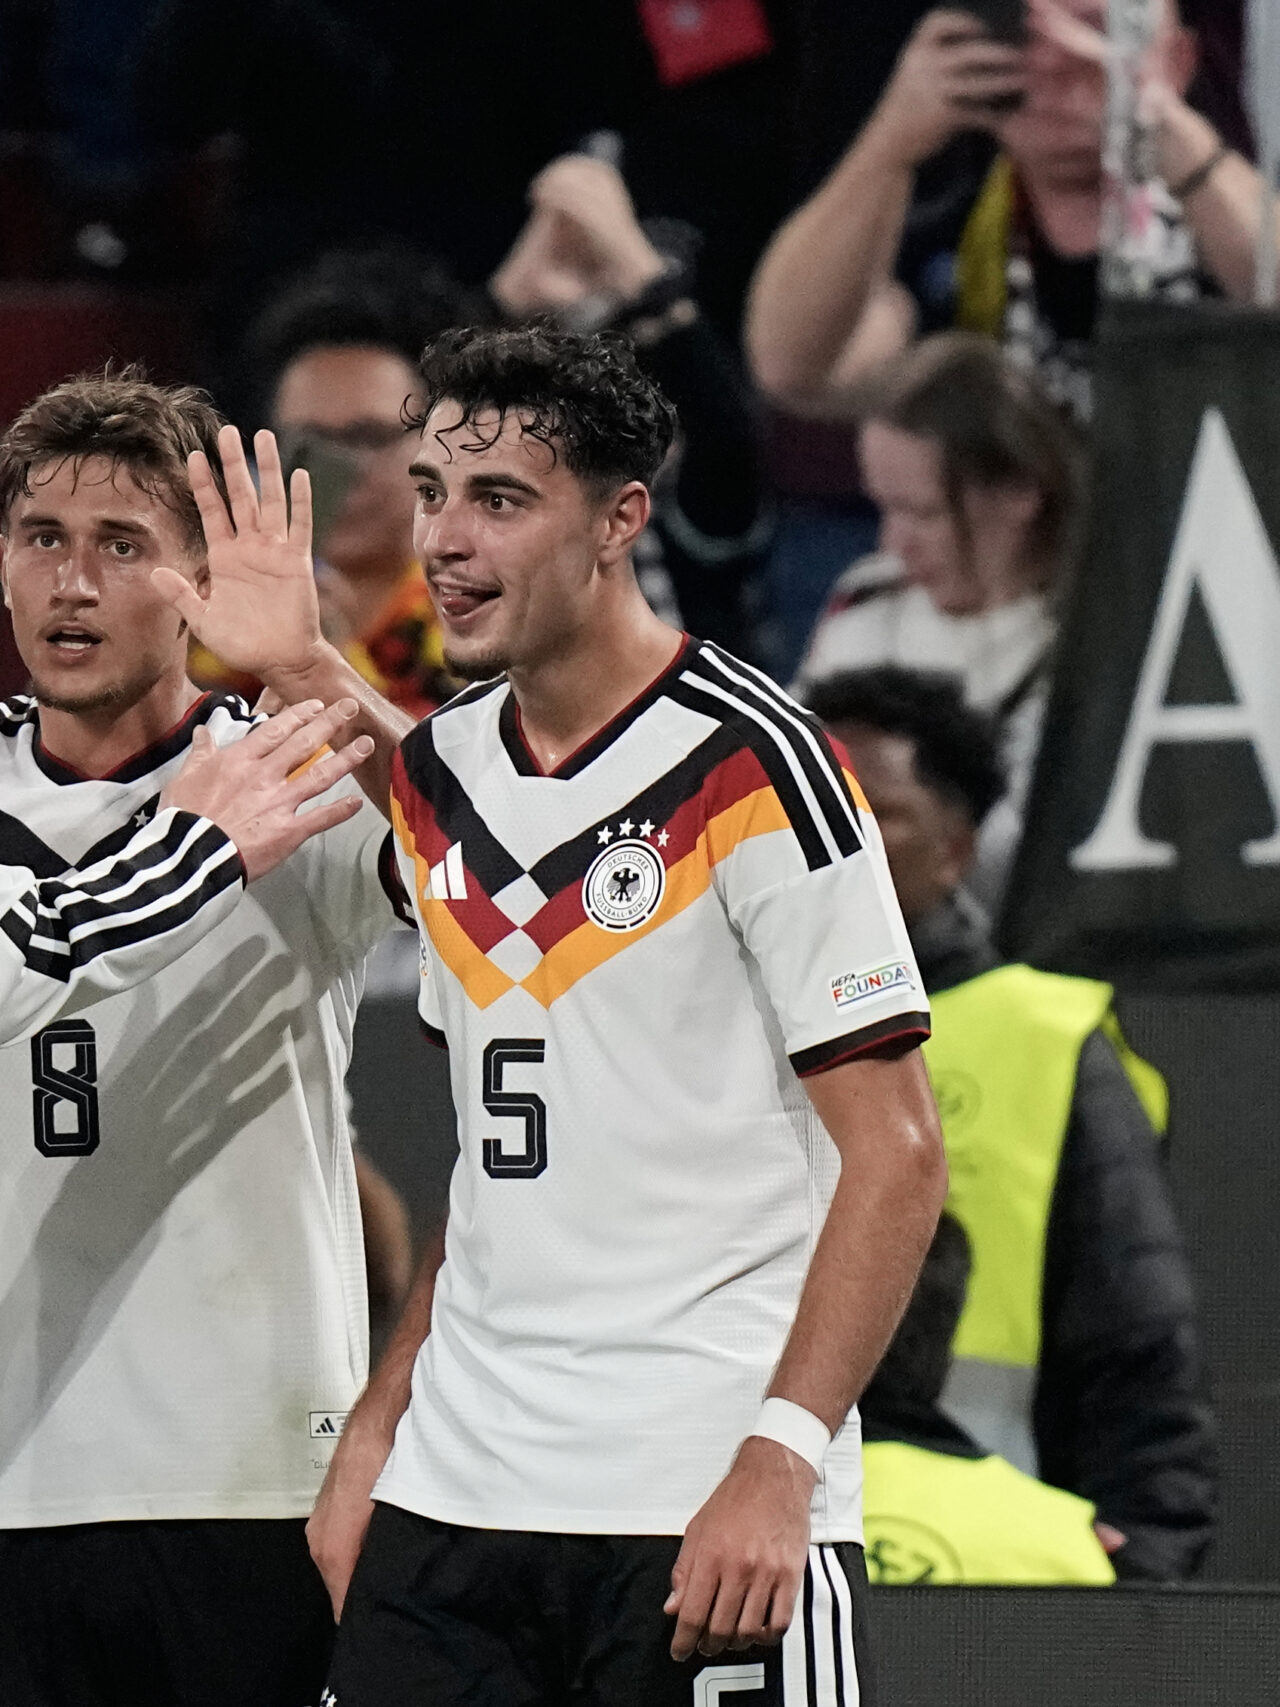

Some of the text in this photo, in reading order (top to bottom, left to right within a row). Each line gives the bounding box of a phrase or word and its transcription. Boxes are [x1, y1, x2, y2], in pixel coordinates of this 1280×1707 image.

[1067, 405, 1280, 872] A
[607, 853, 649, 871] DEUTSCHER
[831, 973, 856, 988] UEFA
[832, 965, 907, 1003] FOUNDA
[31, 1019, 100, 1158] 8
[482, 1038, 548, 1179] 5
